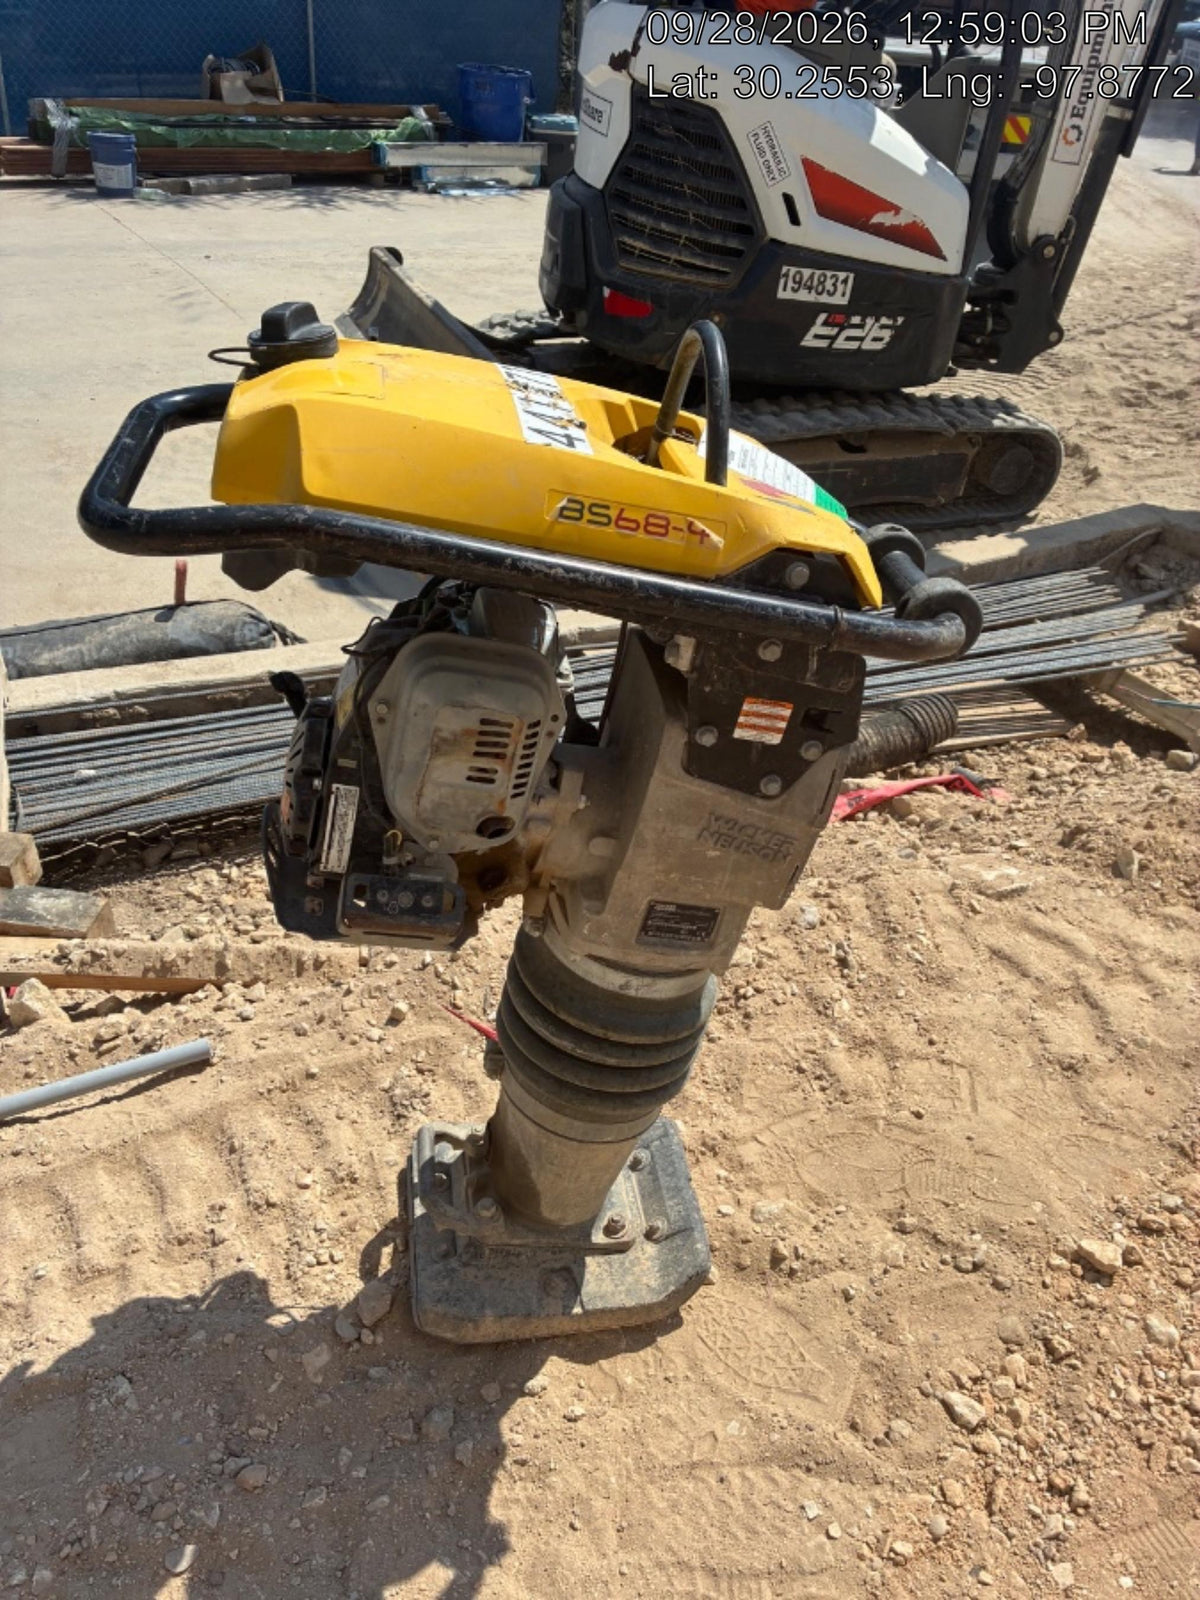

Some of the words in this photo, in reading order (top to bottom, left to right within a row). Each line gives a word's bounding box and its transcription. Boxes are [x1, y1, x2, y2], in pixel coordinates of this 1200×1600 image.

[1070, 0, 1114, 120] Equipmn
[751, 132, 767, 159] FLUID
[762, 159, 777, 182] ONLY
[761, 125, 787, 178] HYDRAULIC
[781, 268, 850, 298] 194831
[557, 497, 711, 545] BS68-4
